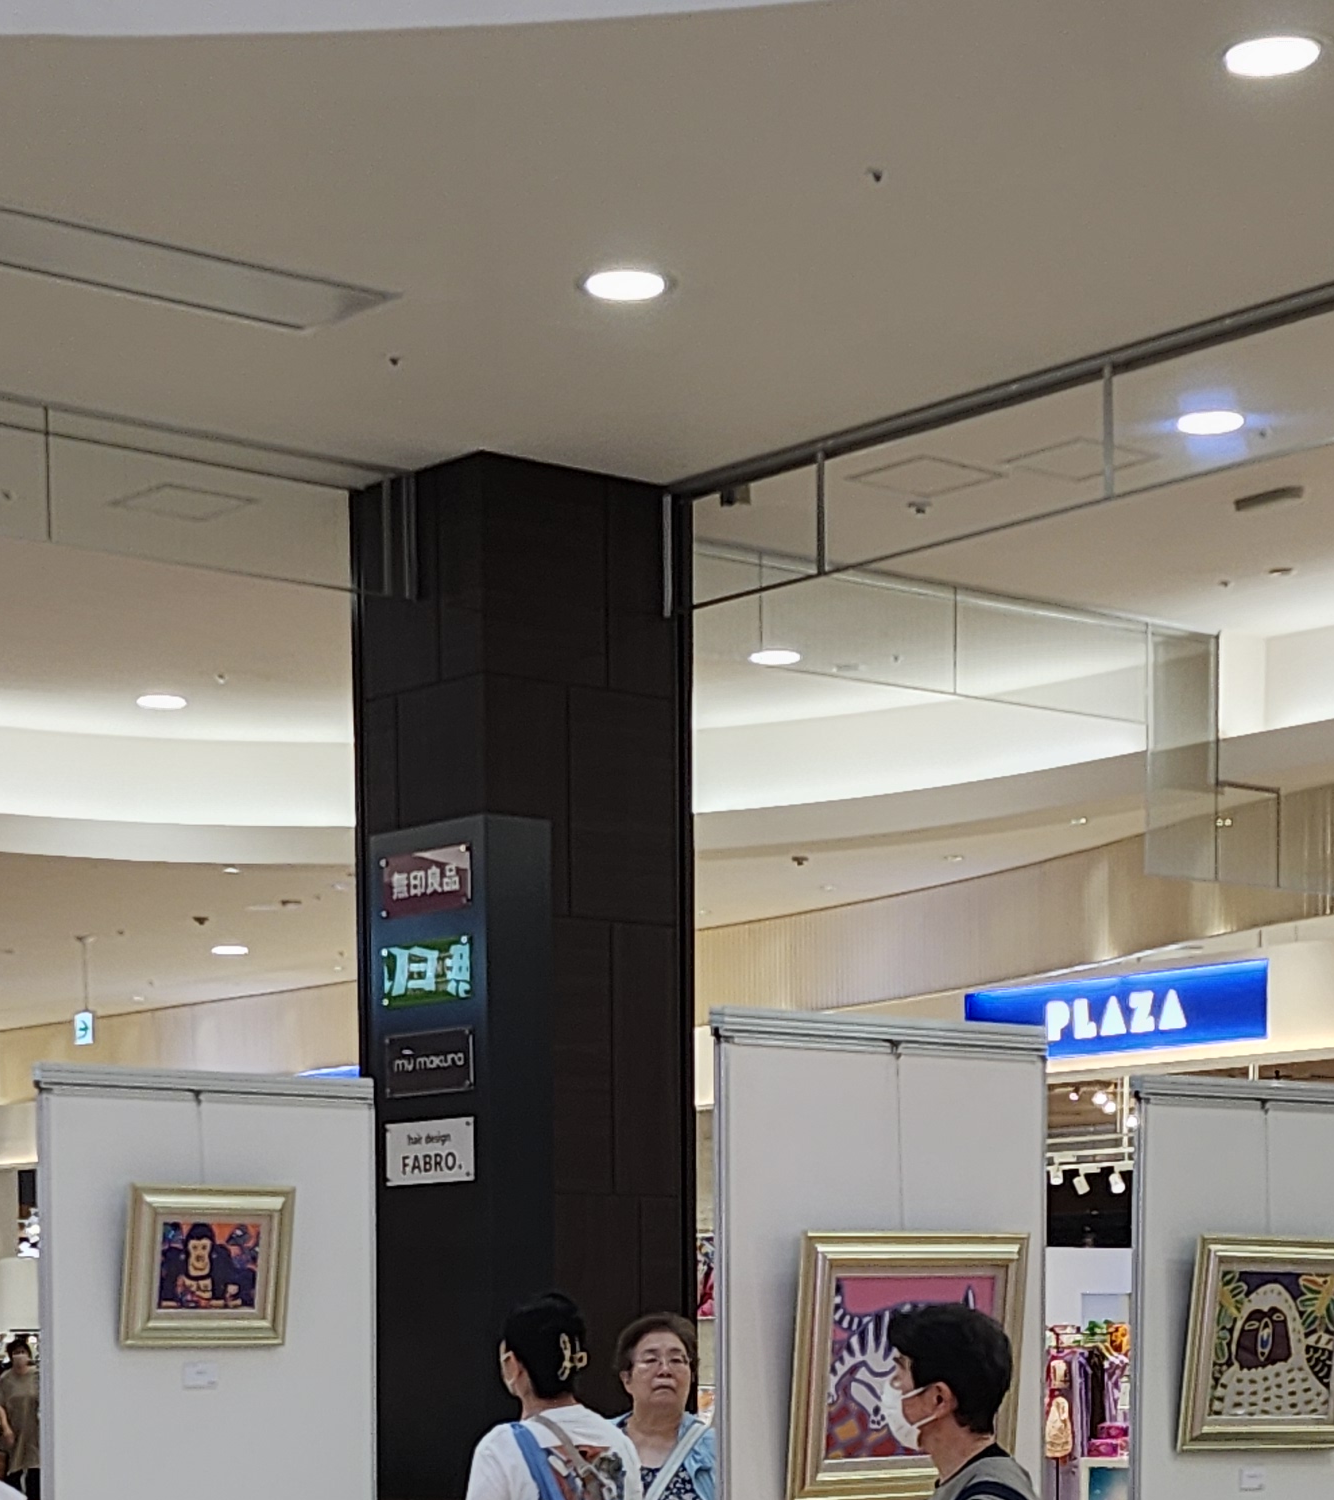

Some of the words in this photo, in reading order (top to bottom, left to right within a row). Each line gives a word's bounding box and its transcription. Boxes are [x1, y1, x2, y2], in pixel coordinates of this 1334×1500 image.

[392, 864, 460, 900] 無印良品
[1045, 989, 1187, 1041] PLAZA
[416, 1052, 464, 1070] makura
